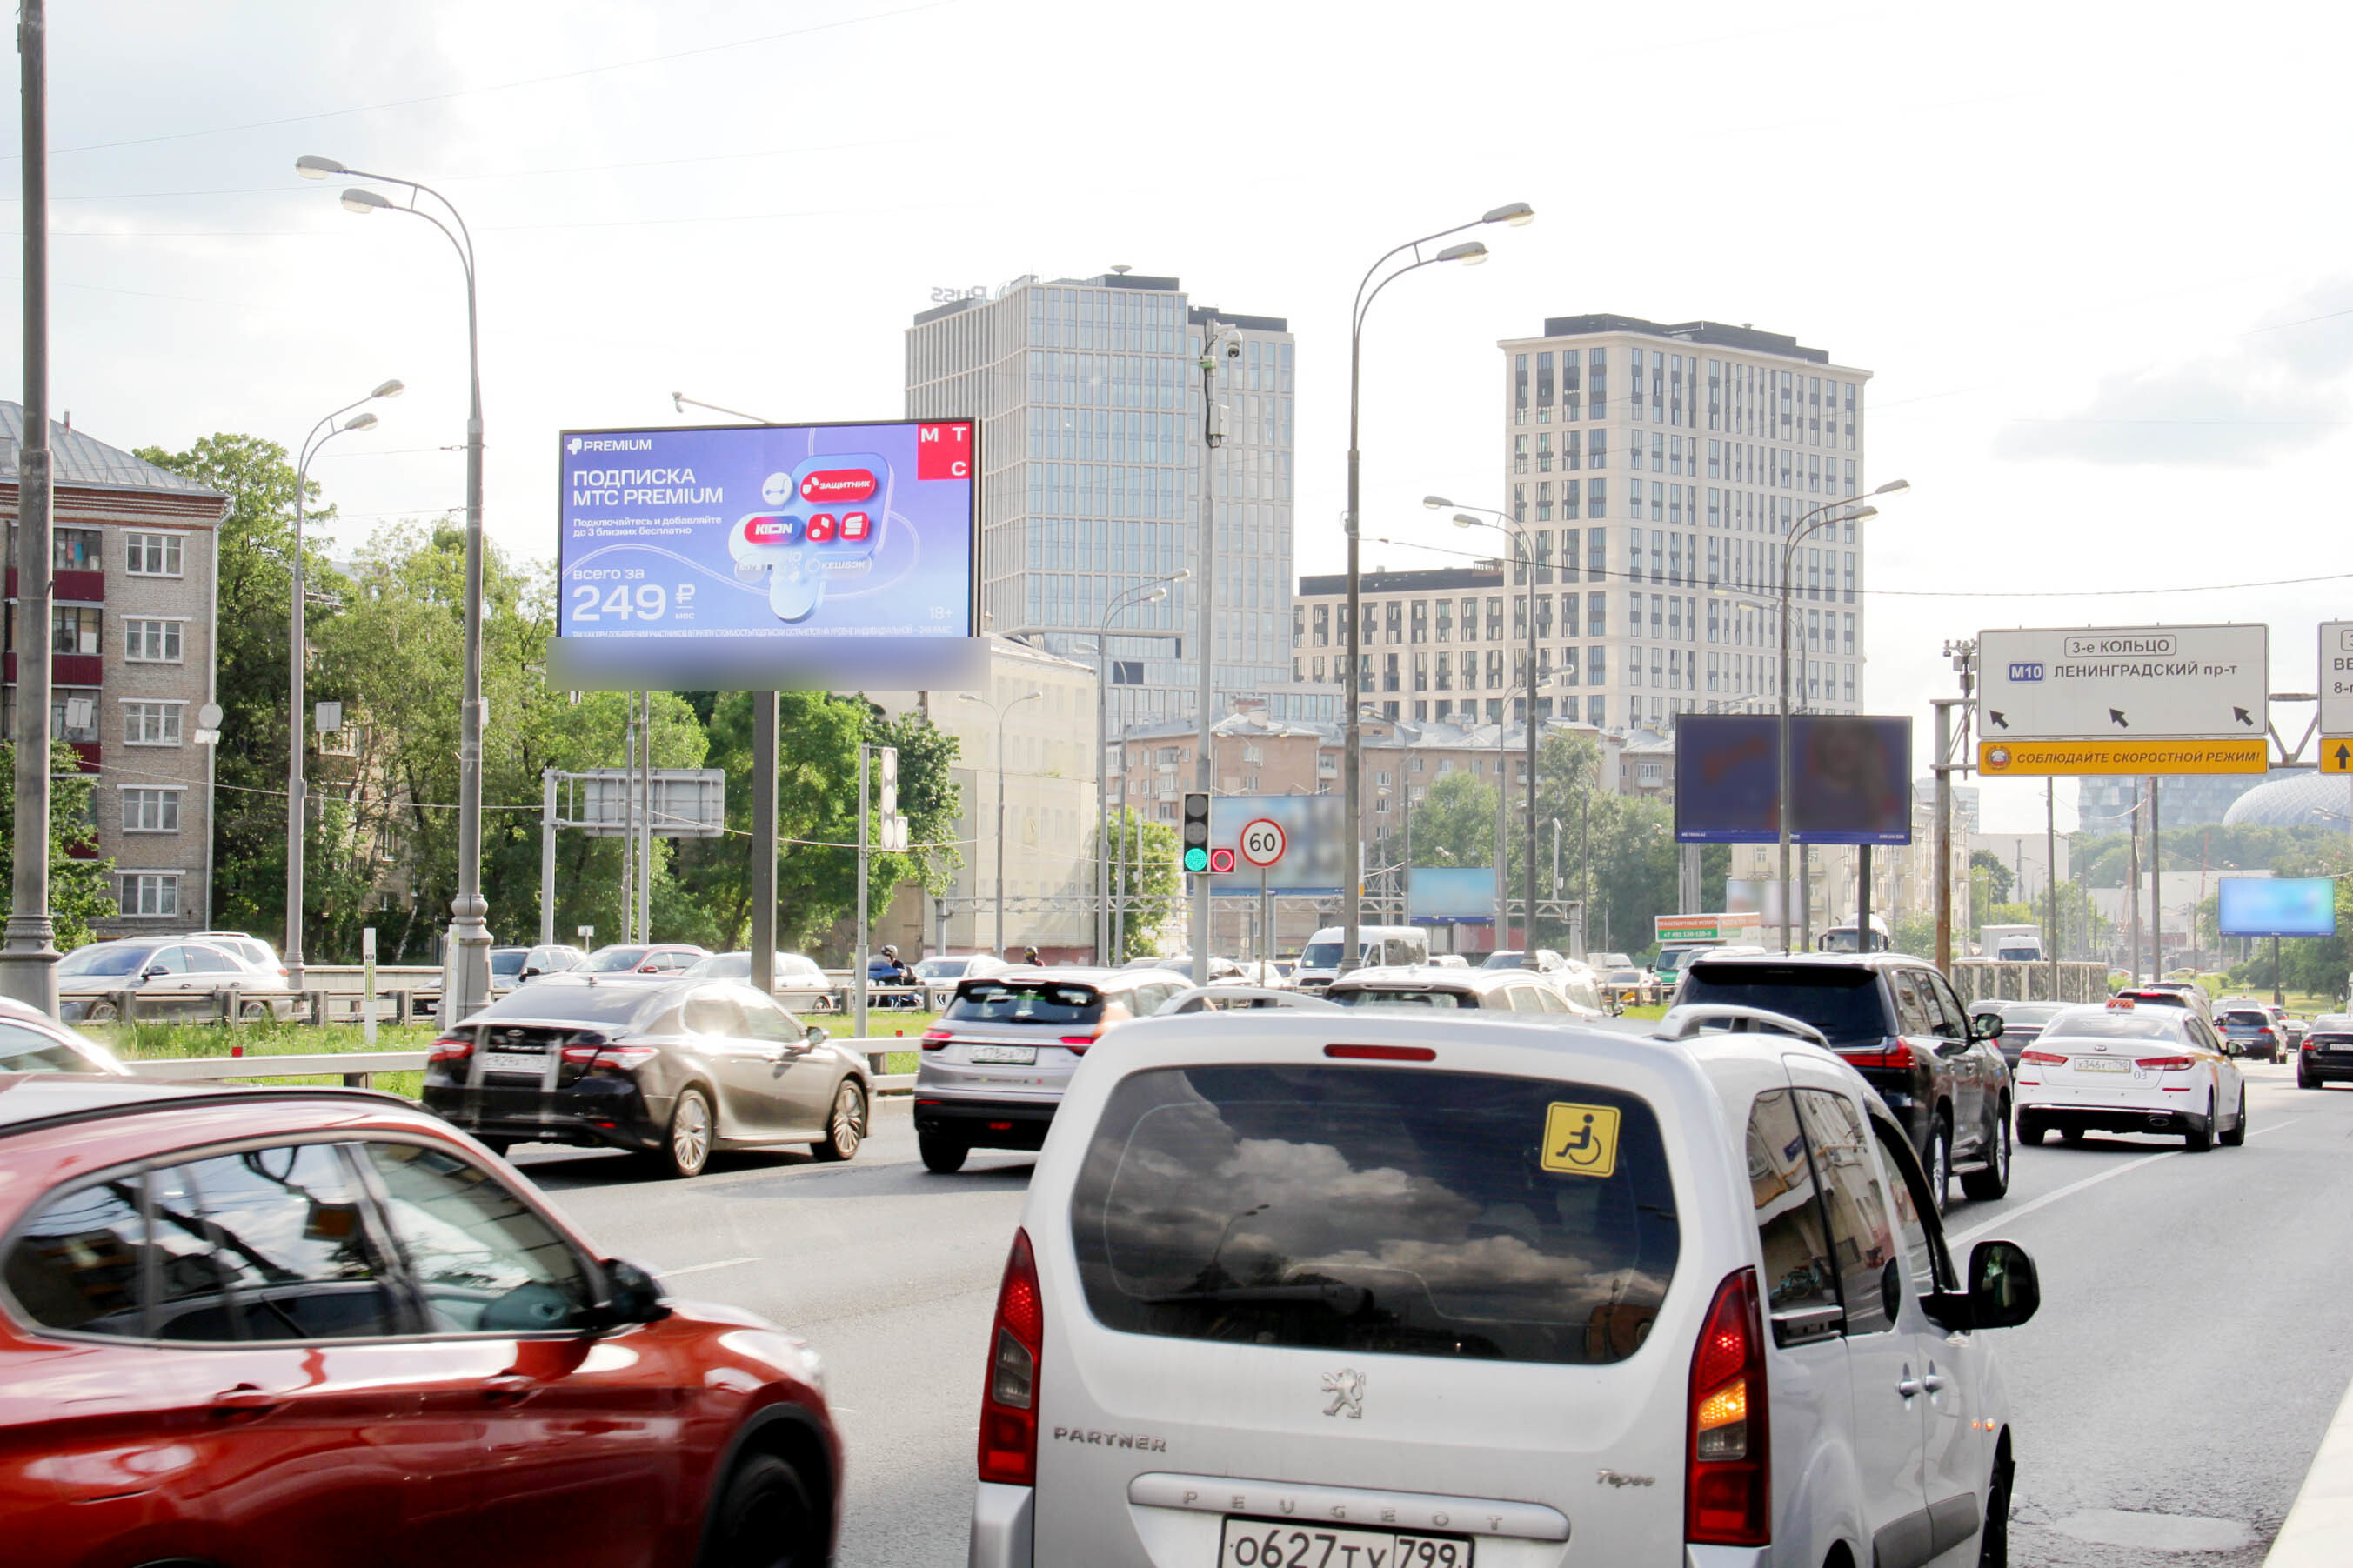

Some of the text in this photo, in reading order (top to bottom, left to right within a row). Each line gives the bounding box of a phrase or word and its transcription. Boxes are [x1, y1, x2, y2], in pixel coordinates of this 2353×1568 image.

[584, 438, 652, 452] PREMIUM
[572, 468, 697, 489] ПОДПИСКА
[819, 480, 871, 490] ЗАЩИТНИК
[572, 487, 724, 507] МТС PREMIUM
[573, 517, 653, 528] Подключайтесь
[662, 515, 723, 527] добавляйте
[572, 525, 692, 537] до 3 близких бесплатно
[755, 523, 793, 536] KION
[572, 569, 645, 581] всего за
[572, 584, 666, 622] 249
[929, 605, 953, 620] 18+
[2072, 639, 2169, 654] 3-е КОЛЬЦО
[2054, 660, 2198, 678] ЛЕНИНГРАДСКИЙ
[2203, 664, 2238, 677] пр-т
[2017, 750, 2261, 764] СОБЛЮДАЙТЕ СКОРОСТНОЙ РЕЖИМ!
[1249, 832, 1276, 852] 60
[2133, 1070, 2148, 1080] 03
[1053, 1426, 1167, 1453] PARTNER
[1596, 1467, 1656, 1489] Tepee
[1182, 1490, 1504, 1531] PEUGEOT
